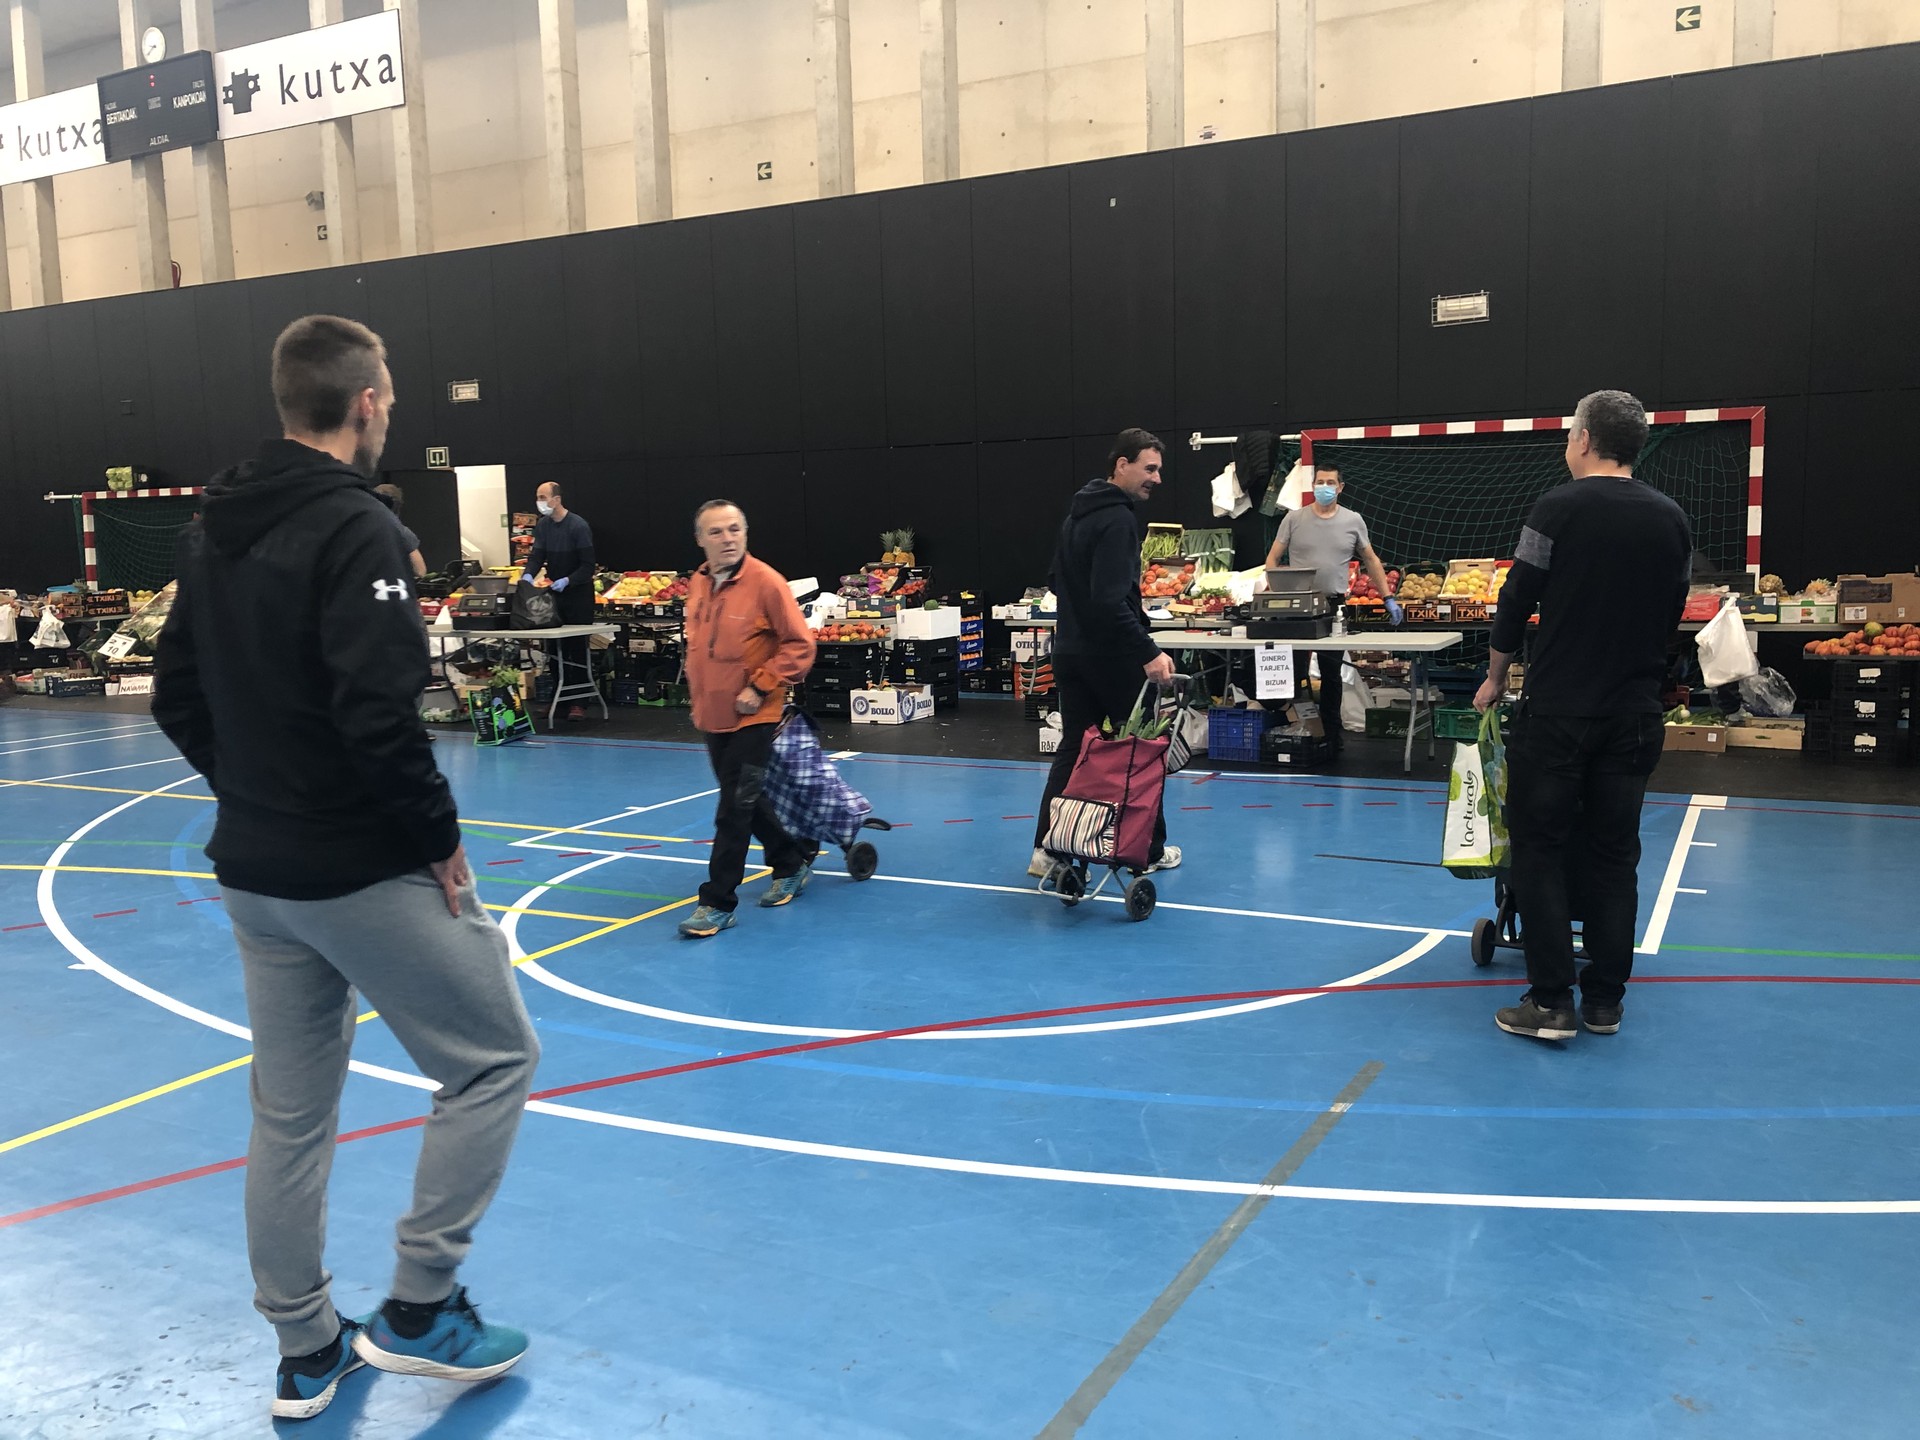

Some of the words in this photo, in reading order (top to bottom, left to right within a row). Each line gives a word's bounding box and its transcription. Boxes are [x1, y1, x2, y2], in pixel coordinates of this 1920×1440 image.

[279, 53, 396, 105] kutxa
[17, 119, 104, 161] kutxa
[1259, 664, 1290, 672] TARJETA
[871, 708, 895, 716] BOLLO
[916, 699, 932, 710] BOLLO
[1460, 770, 1479, 848] lacturale
